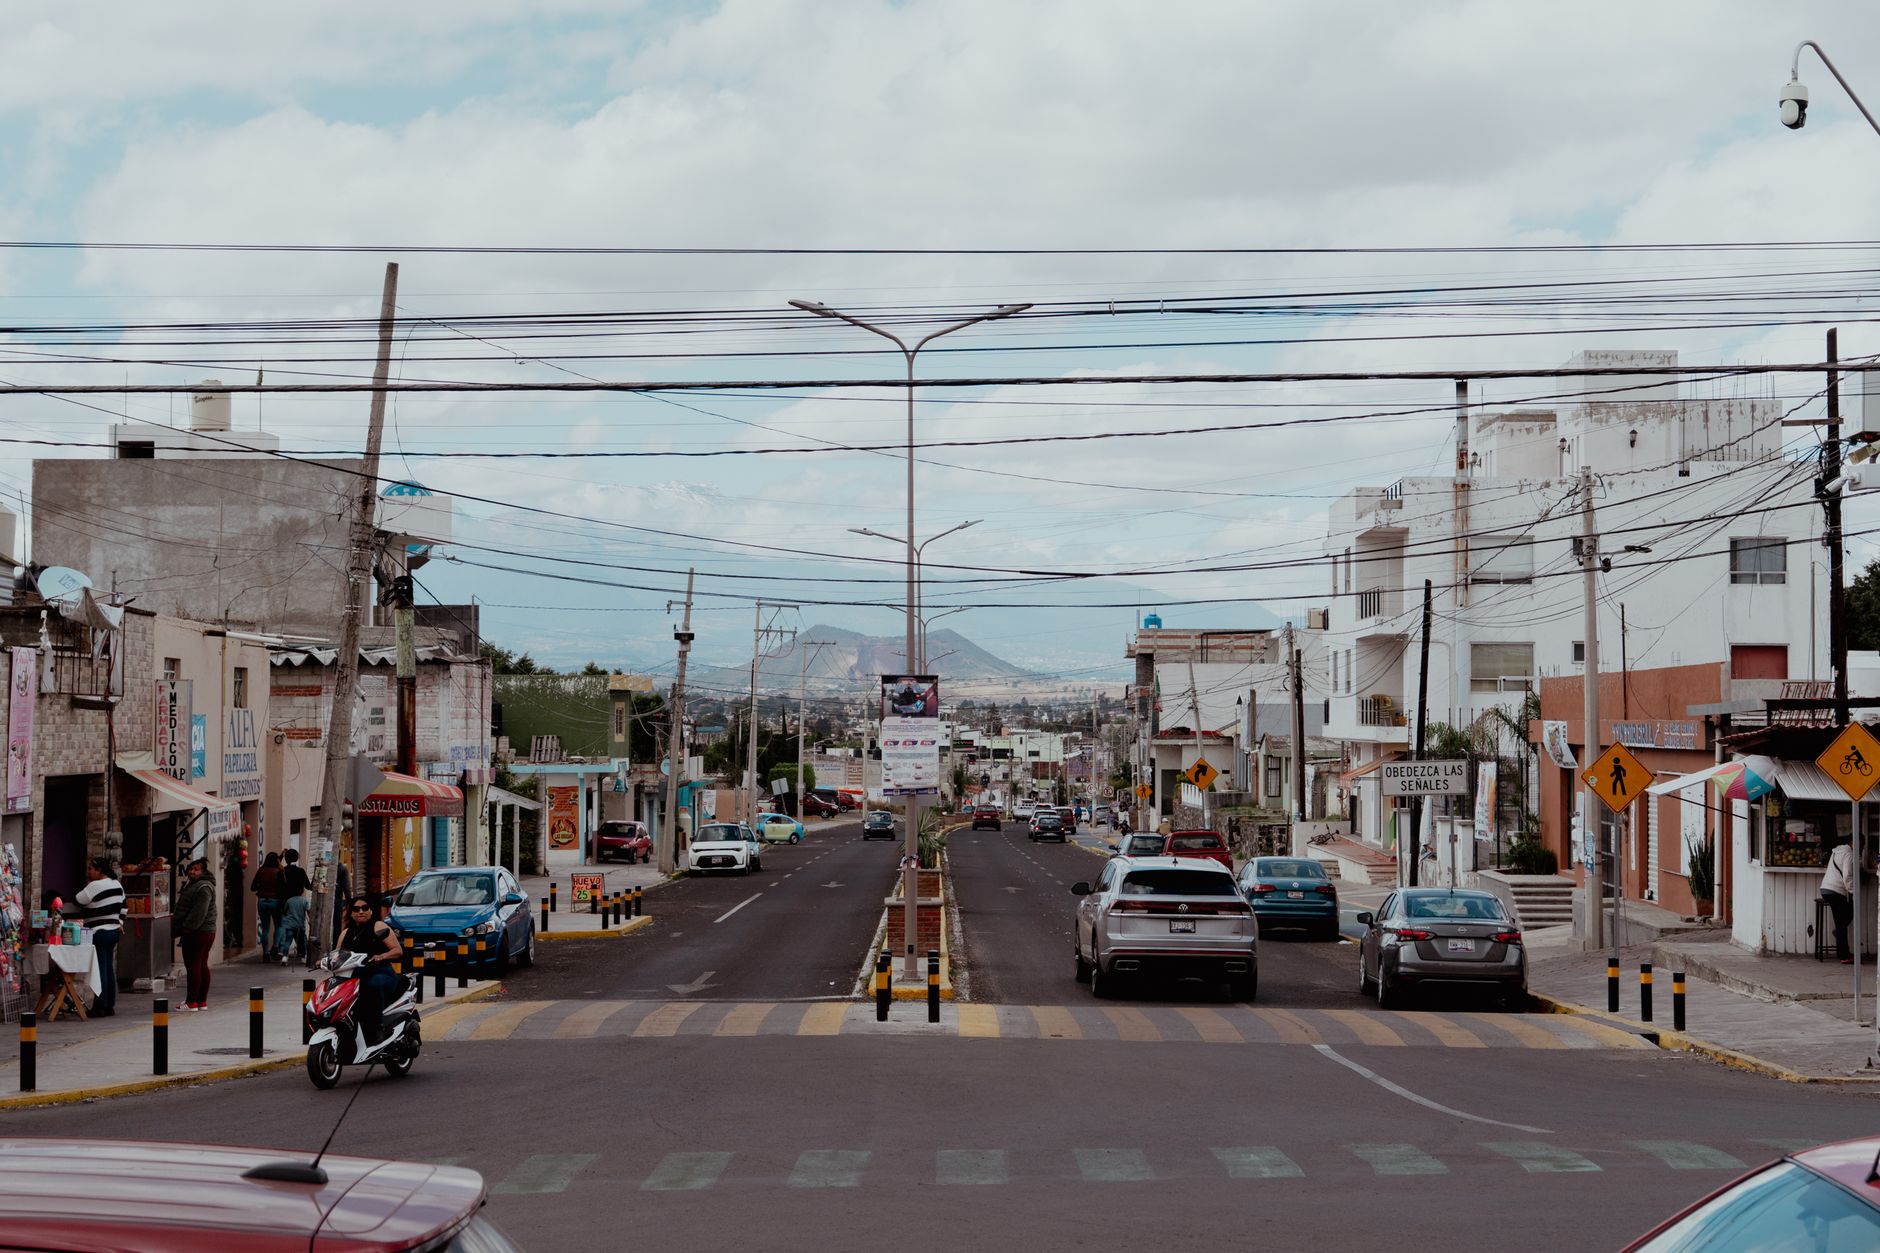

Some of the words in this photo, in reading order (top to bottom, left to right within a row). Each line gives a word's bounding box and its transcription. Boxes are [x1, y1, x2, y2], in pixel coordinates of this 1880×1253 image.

[159, 685, 168, 766] FARMACIA
[169, 692, 177, 767] MEDICO
[228, 709, 257, 748] ALFA
[224, 752, 258, 774] PAPELERIA
[1385, 765, 1440, 778] OBEDEZCA
[1444, 764, 1464, 777] LAS
[1400, 777, 1450, 792] SEÑALES
[358, 799, 421, 814] OSTIZADOS
[573, 877, 601, 886] HUEVO
[576, 890, 588, 900] 25
